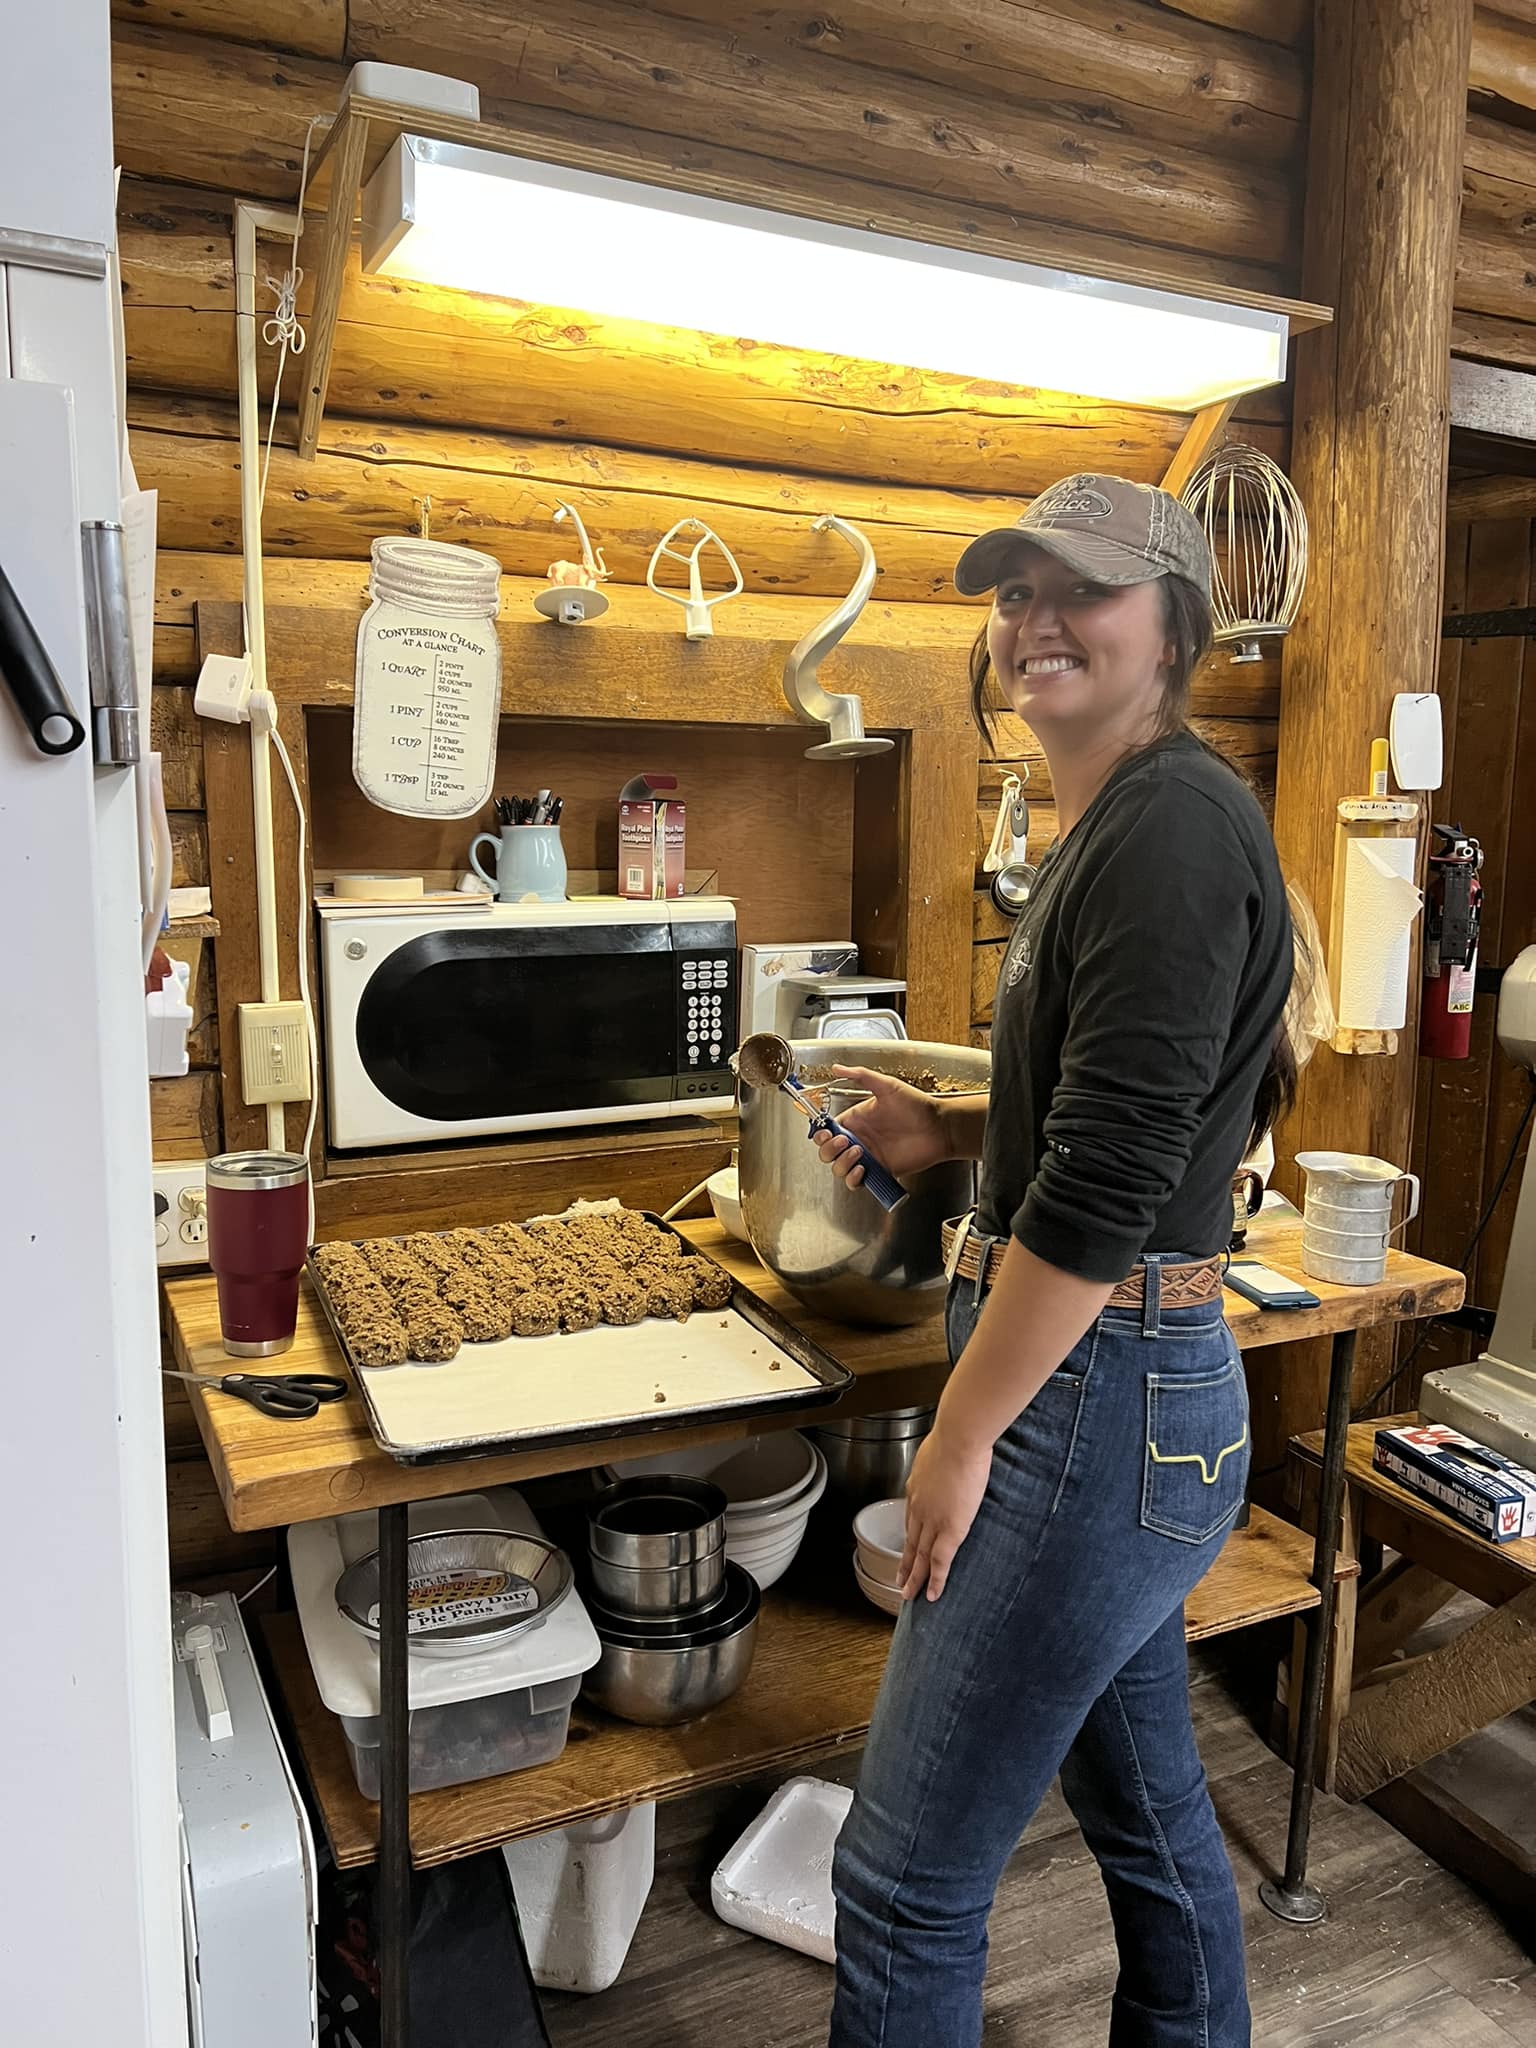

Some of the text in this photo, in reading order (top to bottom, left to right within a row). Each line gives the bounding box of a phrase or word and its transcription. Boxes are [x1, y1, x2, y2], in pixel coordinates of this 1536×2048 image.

[377, 627, 486, 656] CONVERSION CHART
[402, 638, 458, 653] AT A GLANCE
[382, 661, 386, 671] 1
[445, 662, 464, 671] PINTS
[444, 671, 461, 679] CUPS
[447, 679, 473, 688] OUNCES
[437, 685, 450, 693] 950
[390, 704, 424, 717] 1 PINT
[442, 703, 458, 711] CUPS
[444, 711, 470, 721] OUNCES
[391, 736, 422, 748] 1 CUP
[434, 735, 441, 743] 16
[439, 745, 465, 754] OUNCES
[385, 773, 390, 782] 1
[431, 780, 465, 791] 1/2 OUNCE
[430, 788, 438, 796] 15
[621, 834, 652, 845] Toothpicks
[1467, 1490, 1490, 1508] GLOVES
[431, 1599, 483, 1614] Heavy
[488, 1591, 530, 1604] Duty
[419, 1614, 446, 1626] Pie
[452, 1605, 494, 1618] Pans
